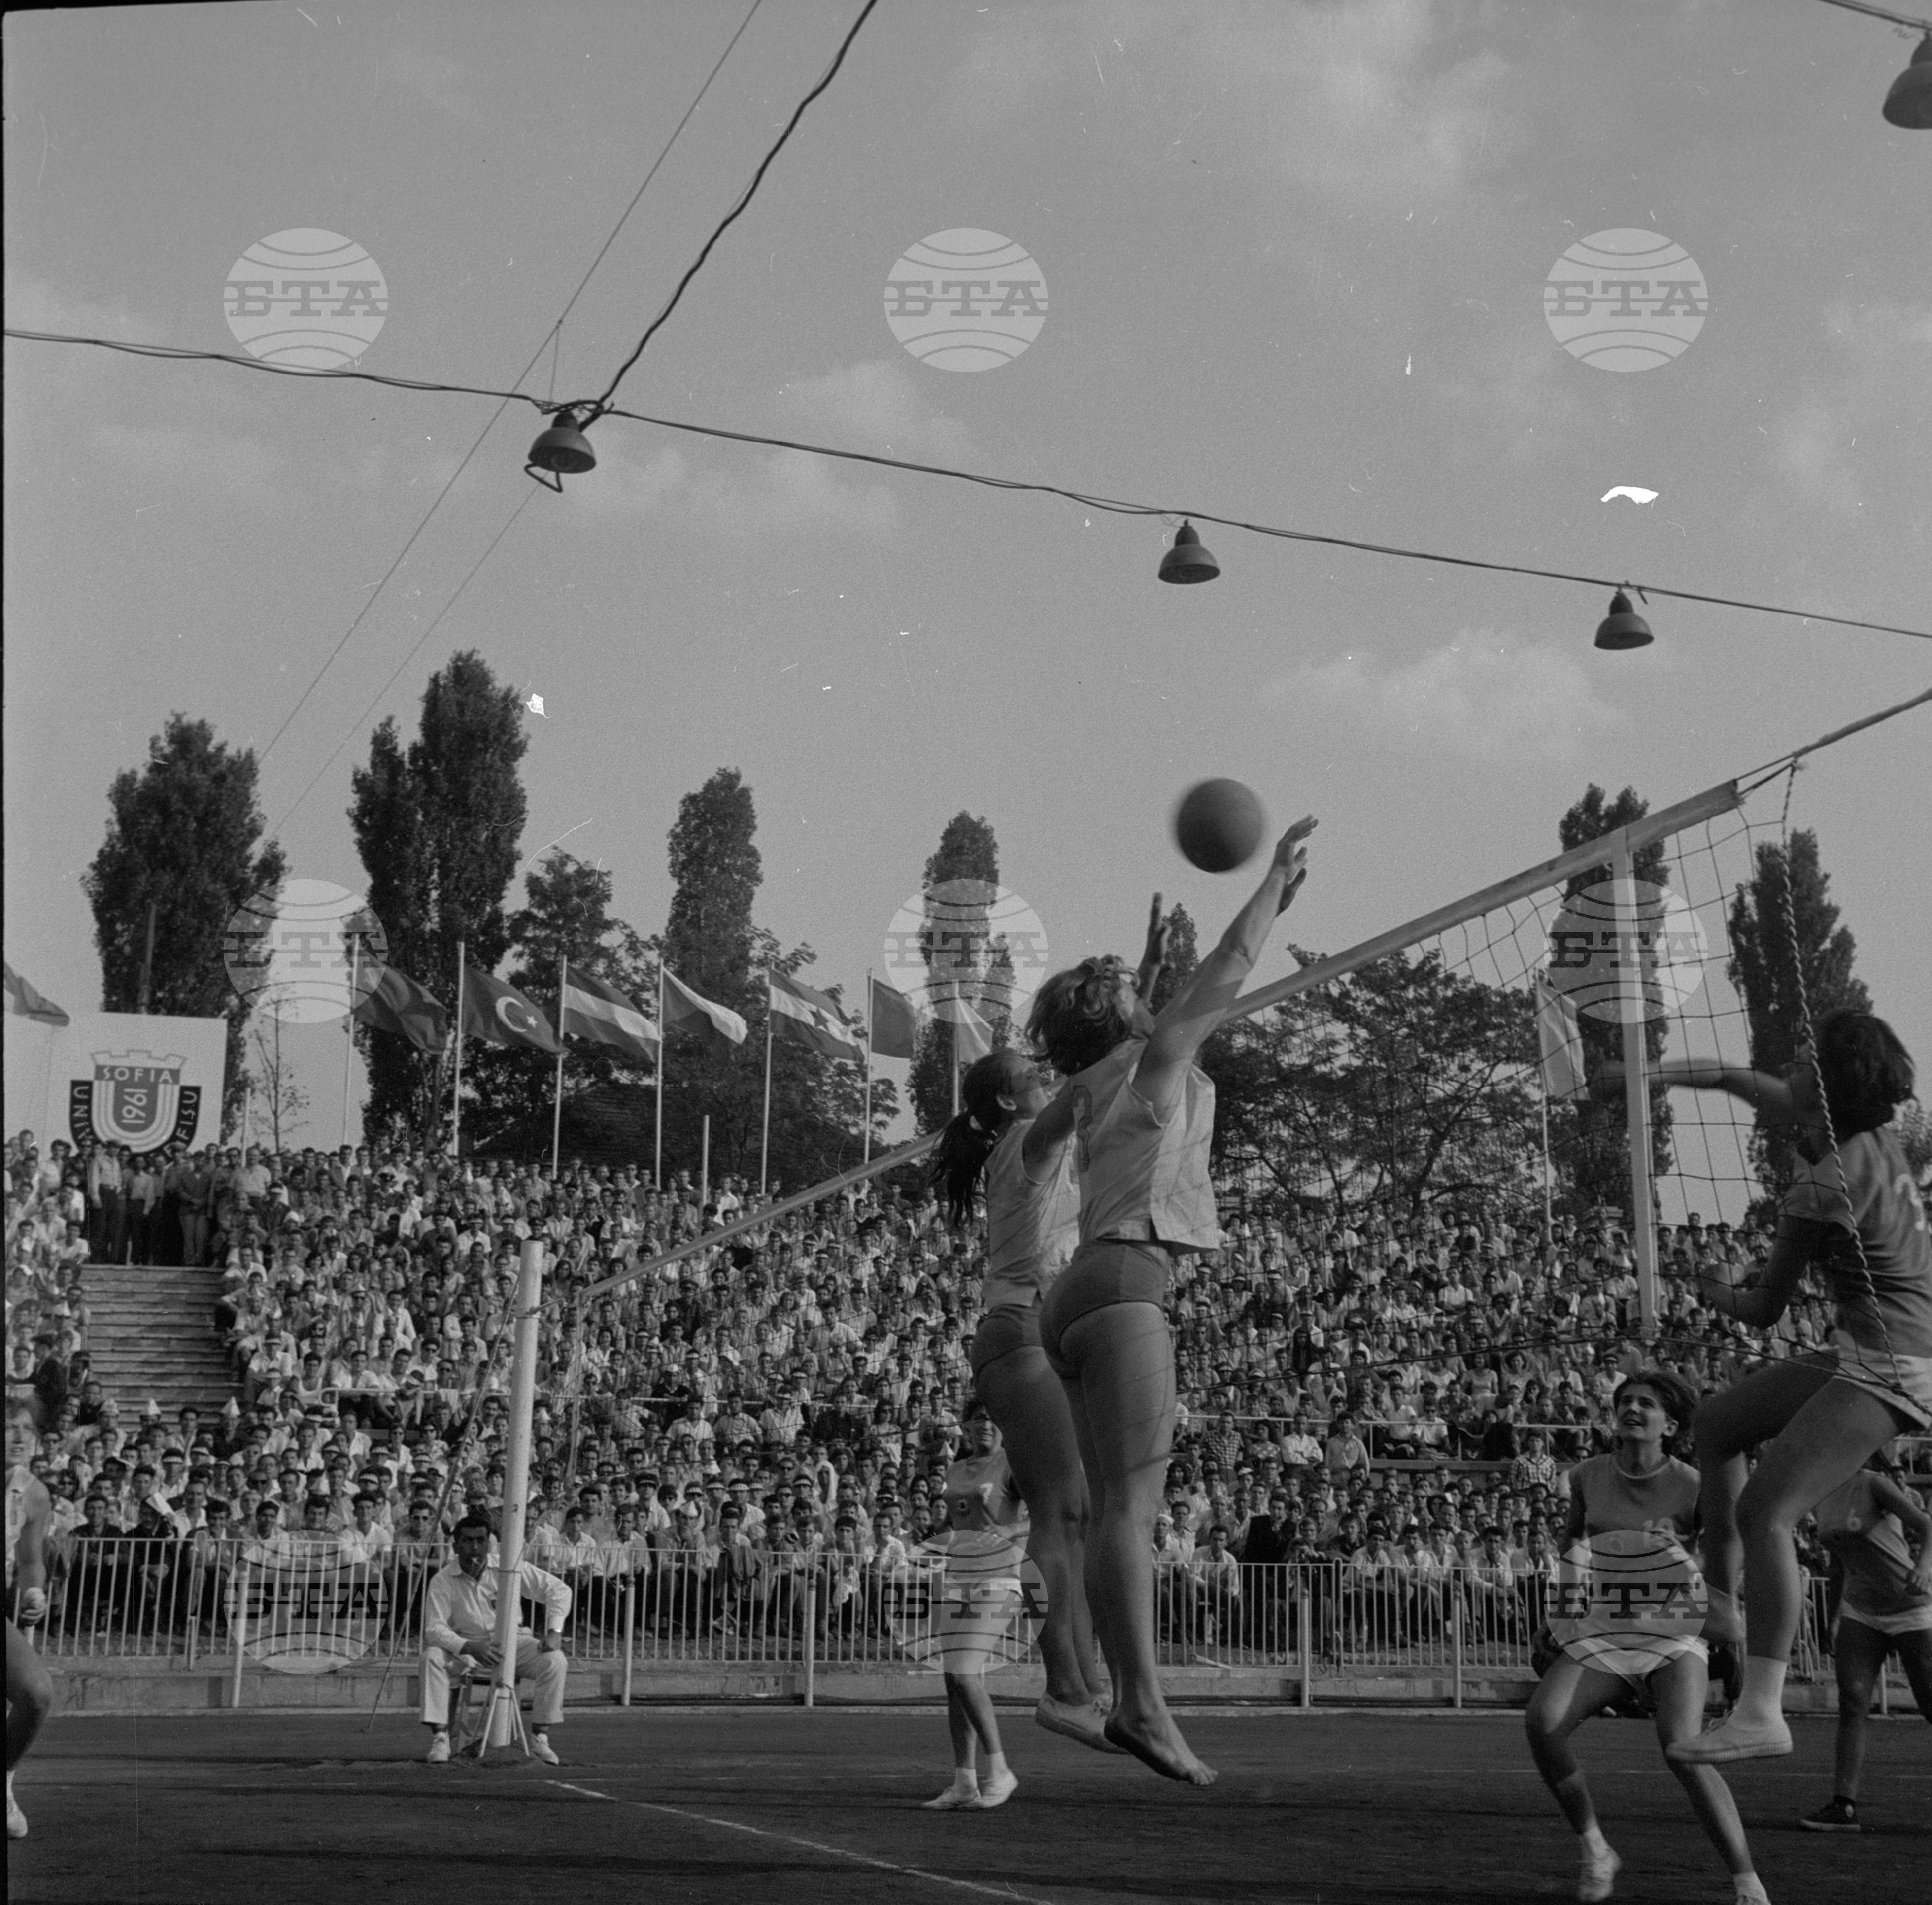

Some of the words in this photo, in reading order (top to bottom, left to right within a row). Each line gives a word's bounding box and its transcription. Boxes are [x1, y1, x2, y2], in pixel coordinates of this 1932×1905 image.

[103, 1067, 173, 1084] SOFIA
[121, 1088, 148, 1123] 1961
[980, 1482, 994, 1506] 7
